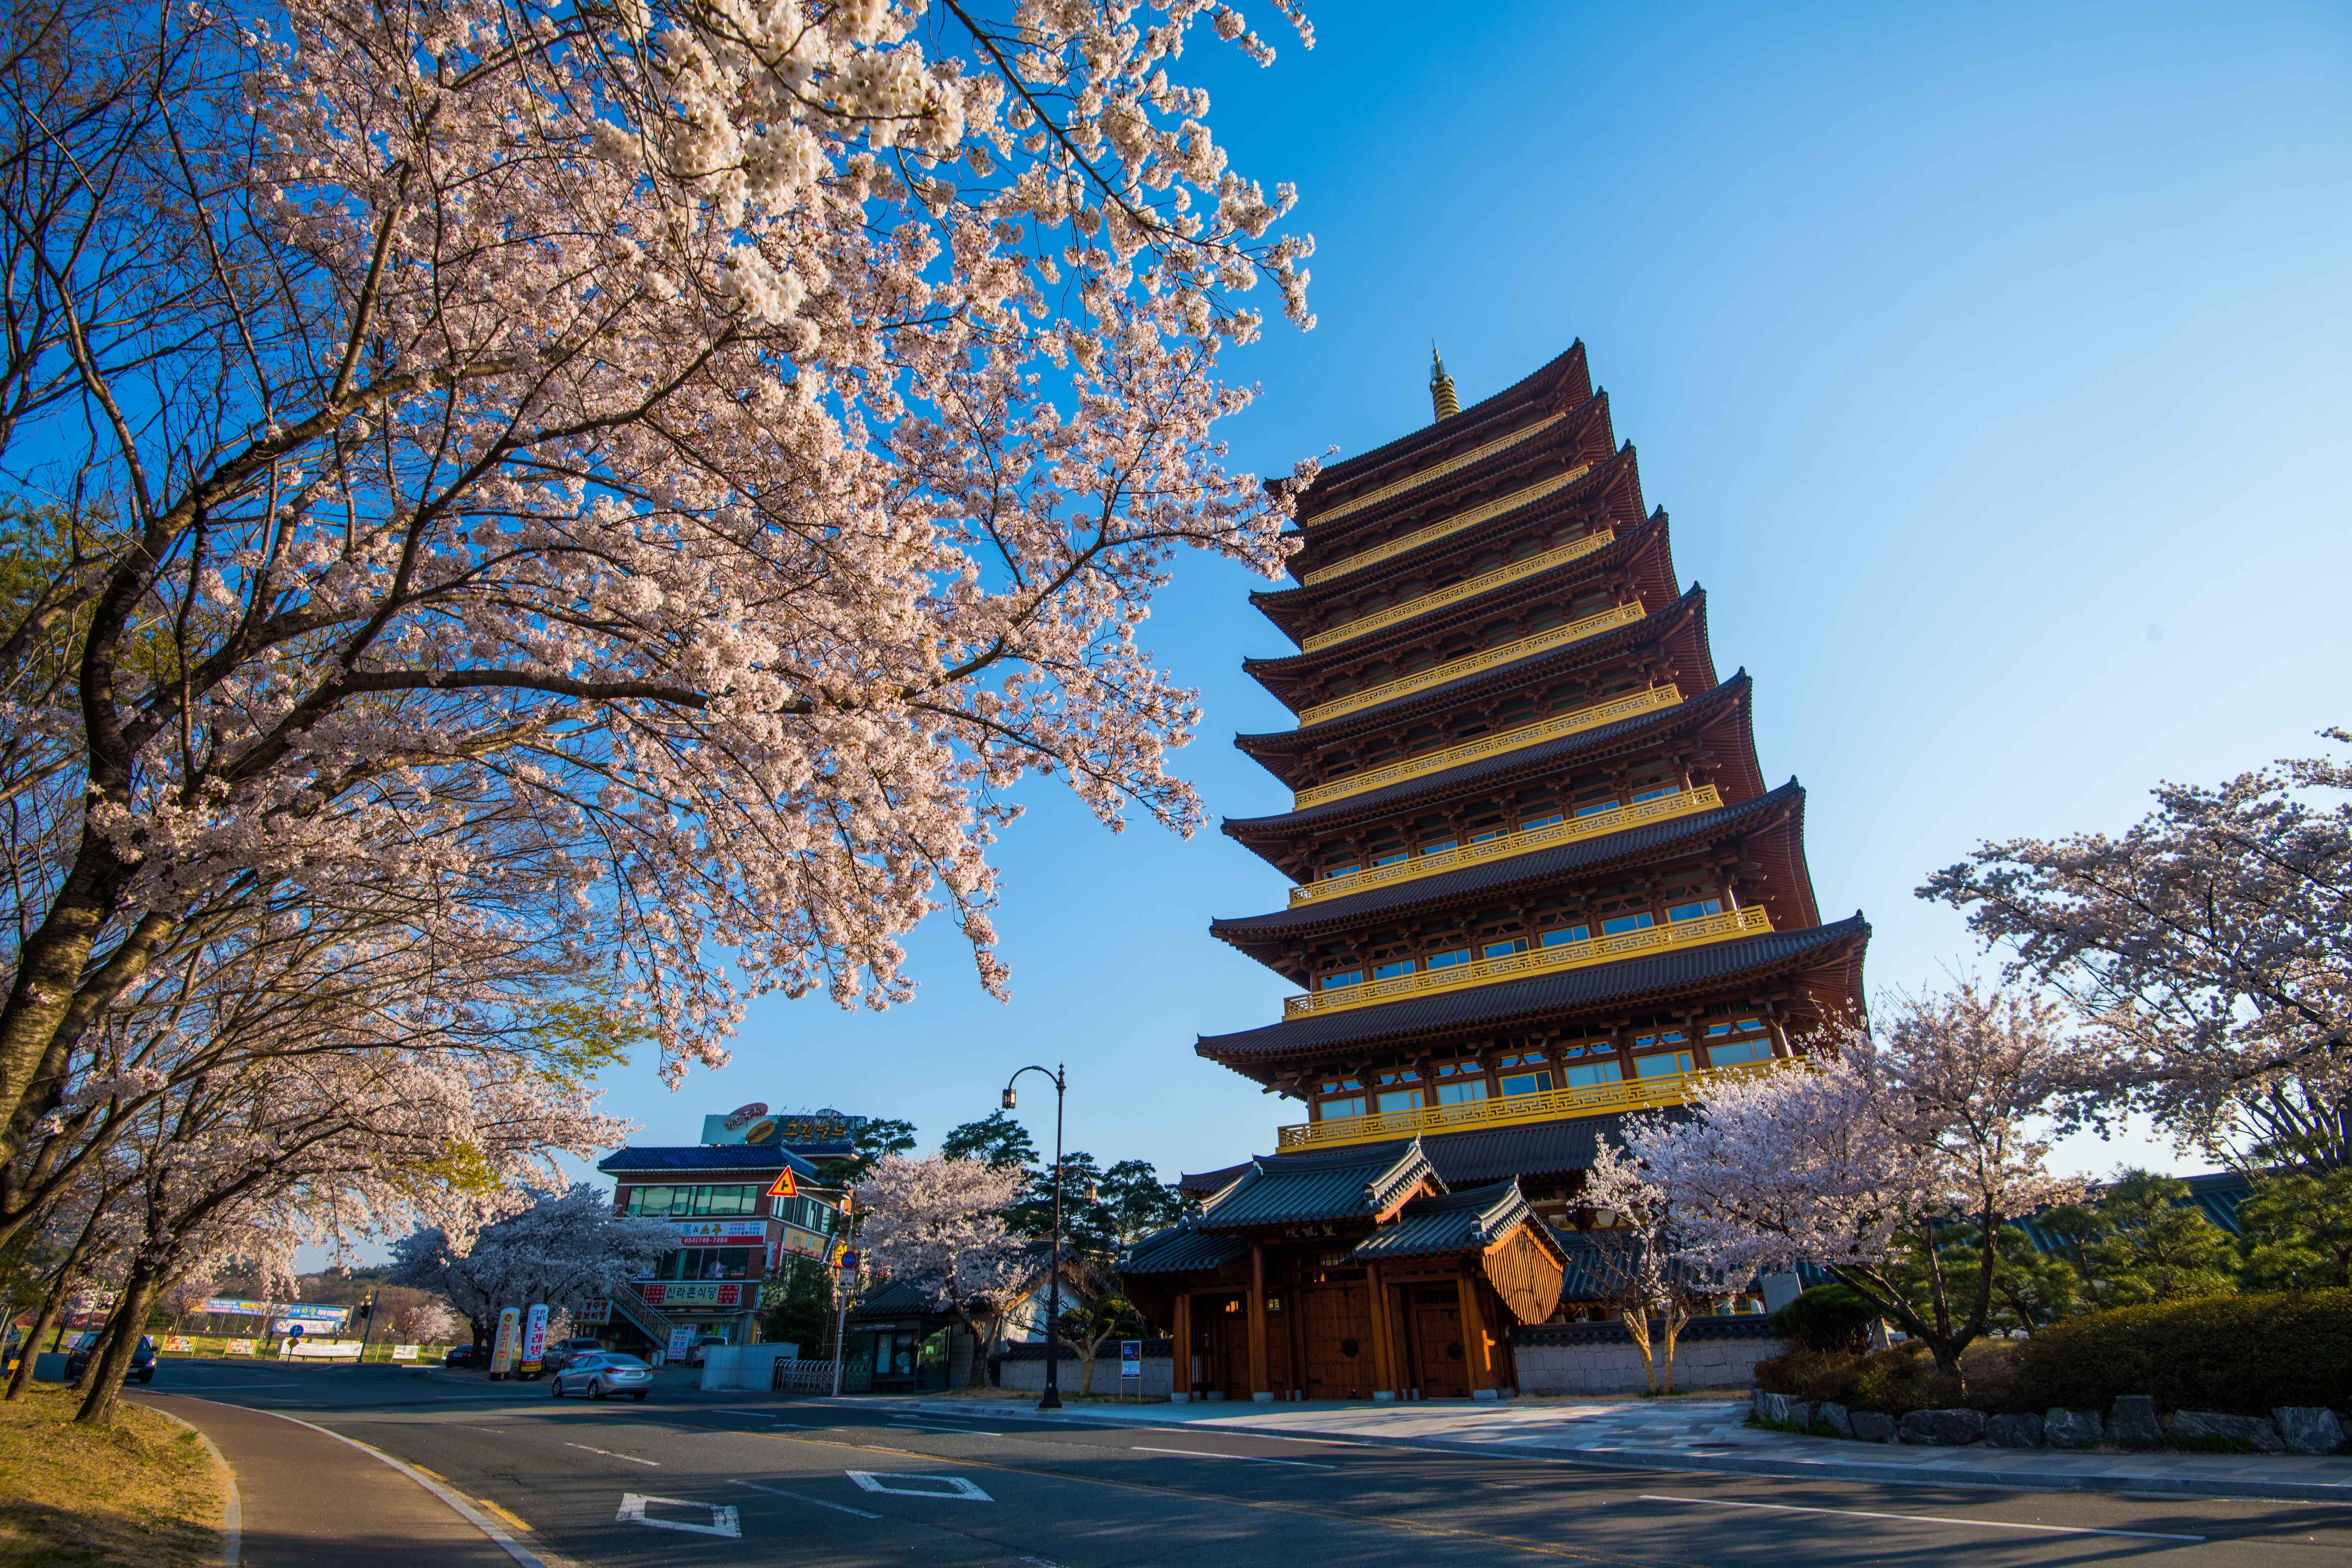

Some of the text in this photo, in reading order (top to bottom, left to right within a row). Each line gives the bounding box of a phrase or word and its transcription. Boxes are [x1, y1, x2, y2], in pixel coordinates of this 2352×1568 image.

[700, 1224, 722, 1236] 소주
[666, 1286, 717, 1300] 신라촌식당
[498, 1323, 511, 1358] 찰보리빵
[531, 1322, 544, 1356] 노래방
